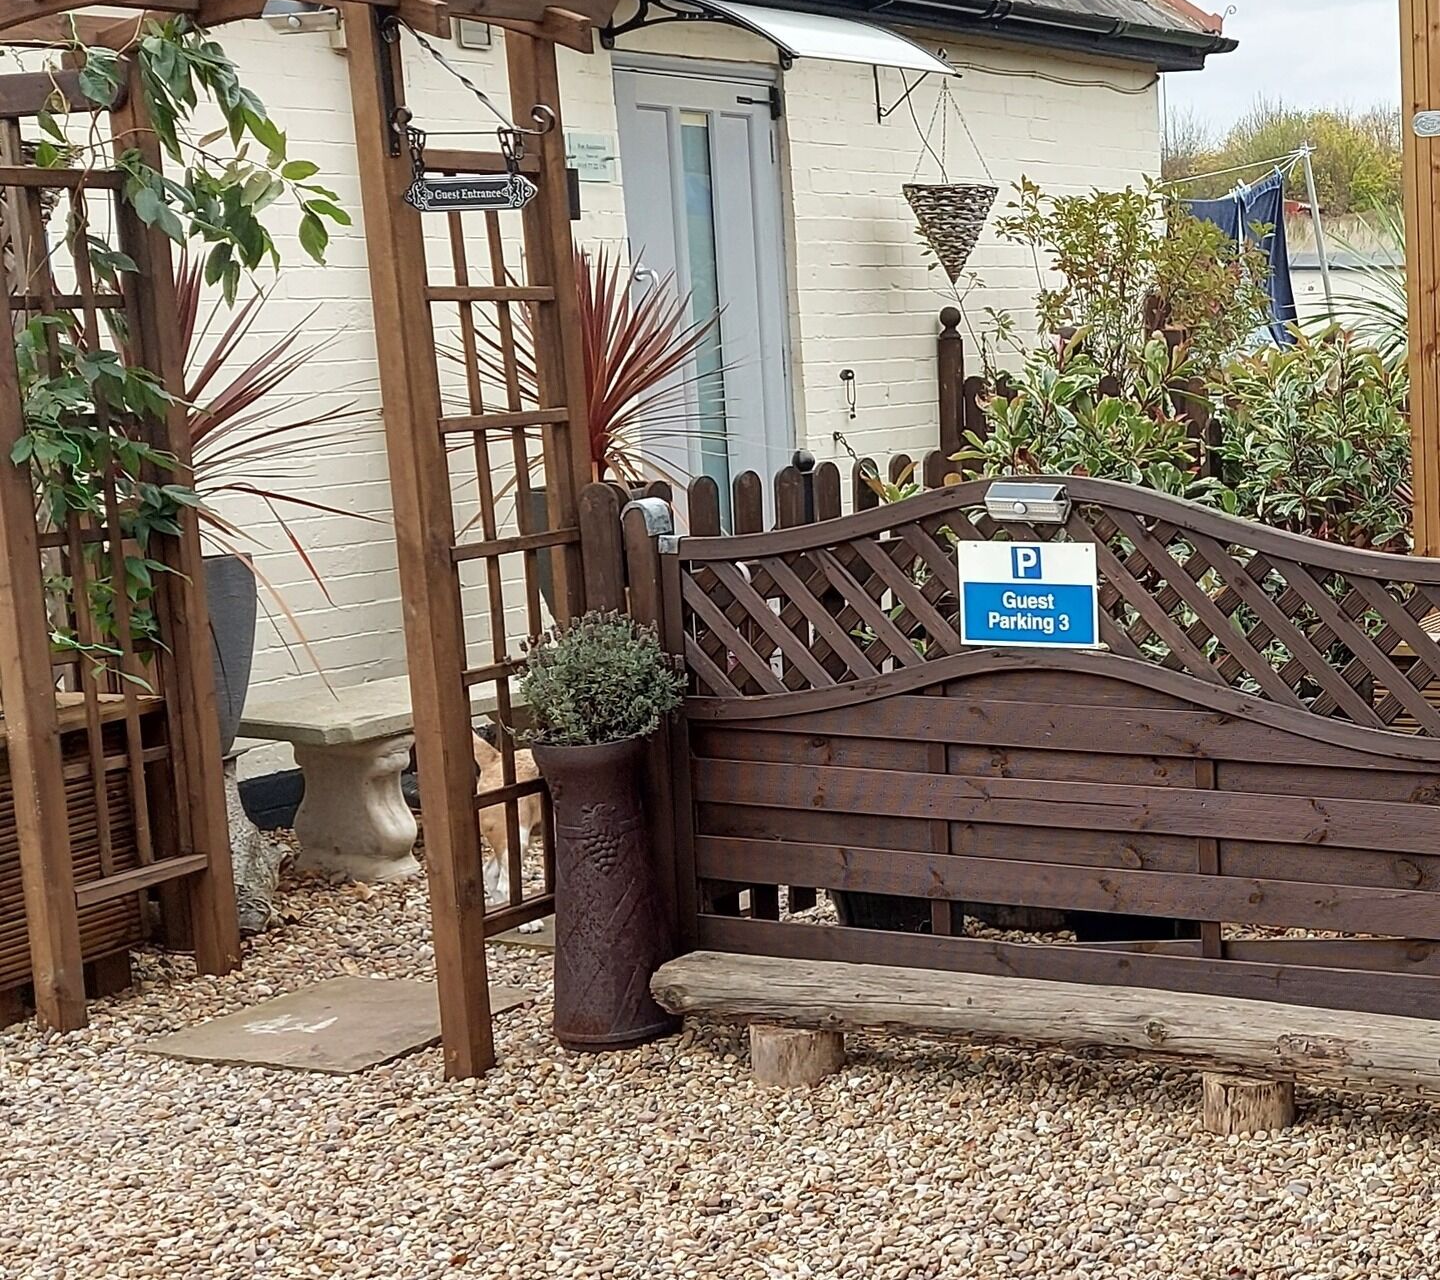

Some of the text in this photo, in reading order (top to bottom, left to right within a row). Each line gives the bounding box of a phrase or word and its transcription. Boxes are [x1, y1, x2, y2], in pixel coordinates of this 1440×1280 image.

[434, 188, 501, 200] Guest Entrance
[1016, 548, 1037, 577] P
[1002, 591, 1055, 609] Guest
[988, 612, 1070, 634] Parking 3
